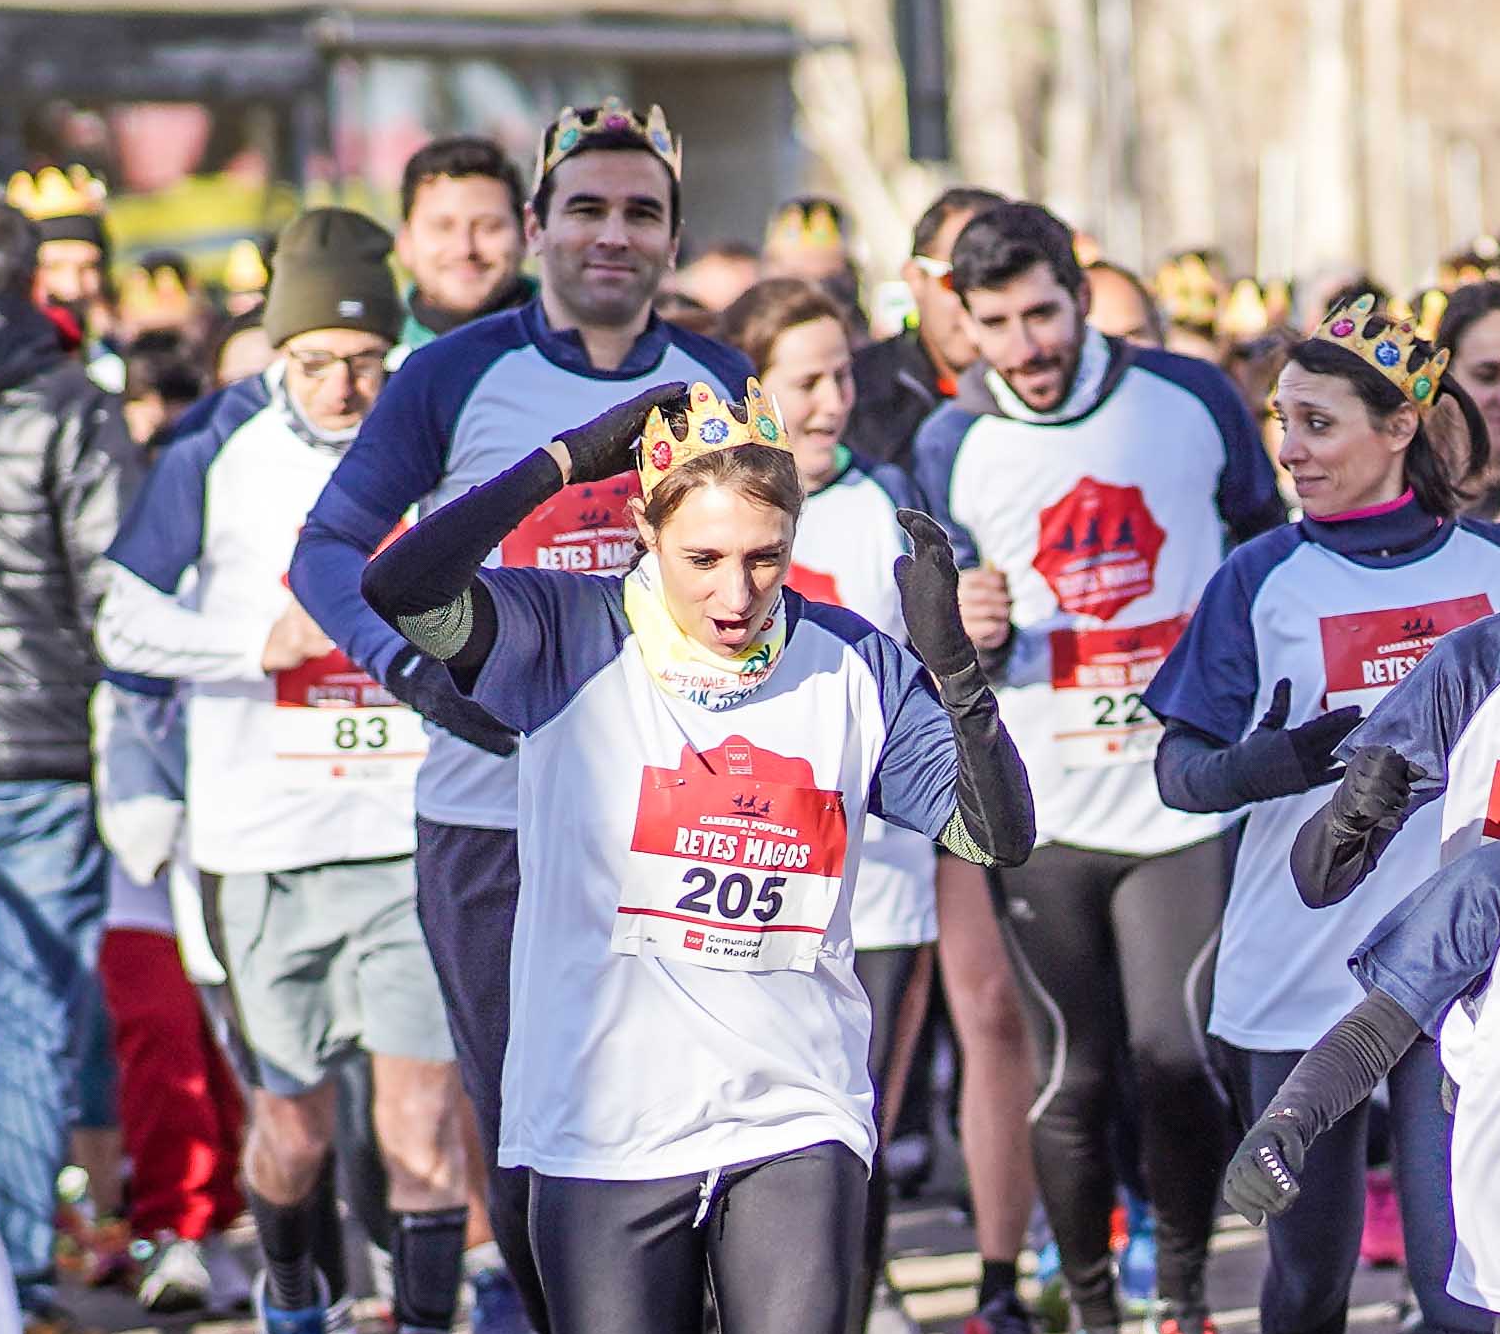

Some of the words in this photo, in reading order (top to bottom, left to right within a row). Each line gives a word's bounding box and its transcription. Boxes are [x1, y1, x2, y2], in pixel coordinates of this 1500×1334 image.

[1362, 656, 1418, 684] REYES
[336, 716, 388, 749] 83
[699, 816, 750, 829] CARRERA
[751, 820, 798, 838] POPULAR
[674, 827, 739, 861] REYES
[743, 837, 811, 868] MAGOS
[676, 867, 787, 923] 205
[705, 945, 720, 955] de
[723, 947, 760, 959] Madrid
[1259, 1146, 1291, 1191] KIPSTA
